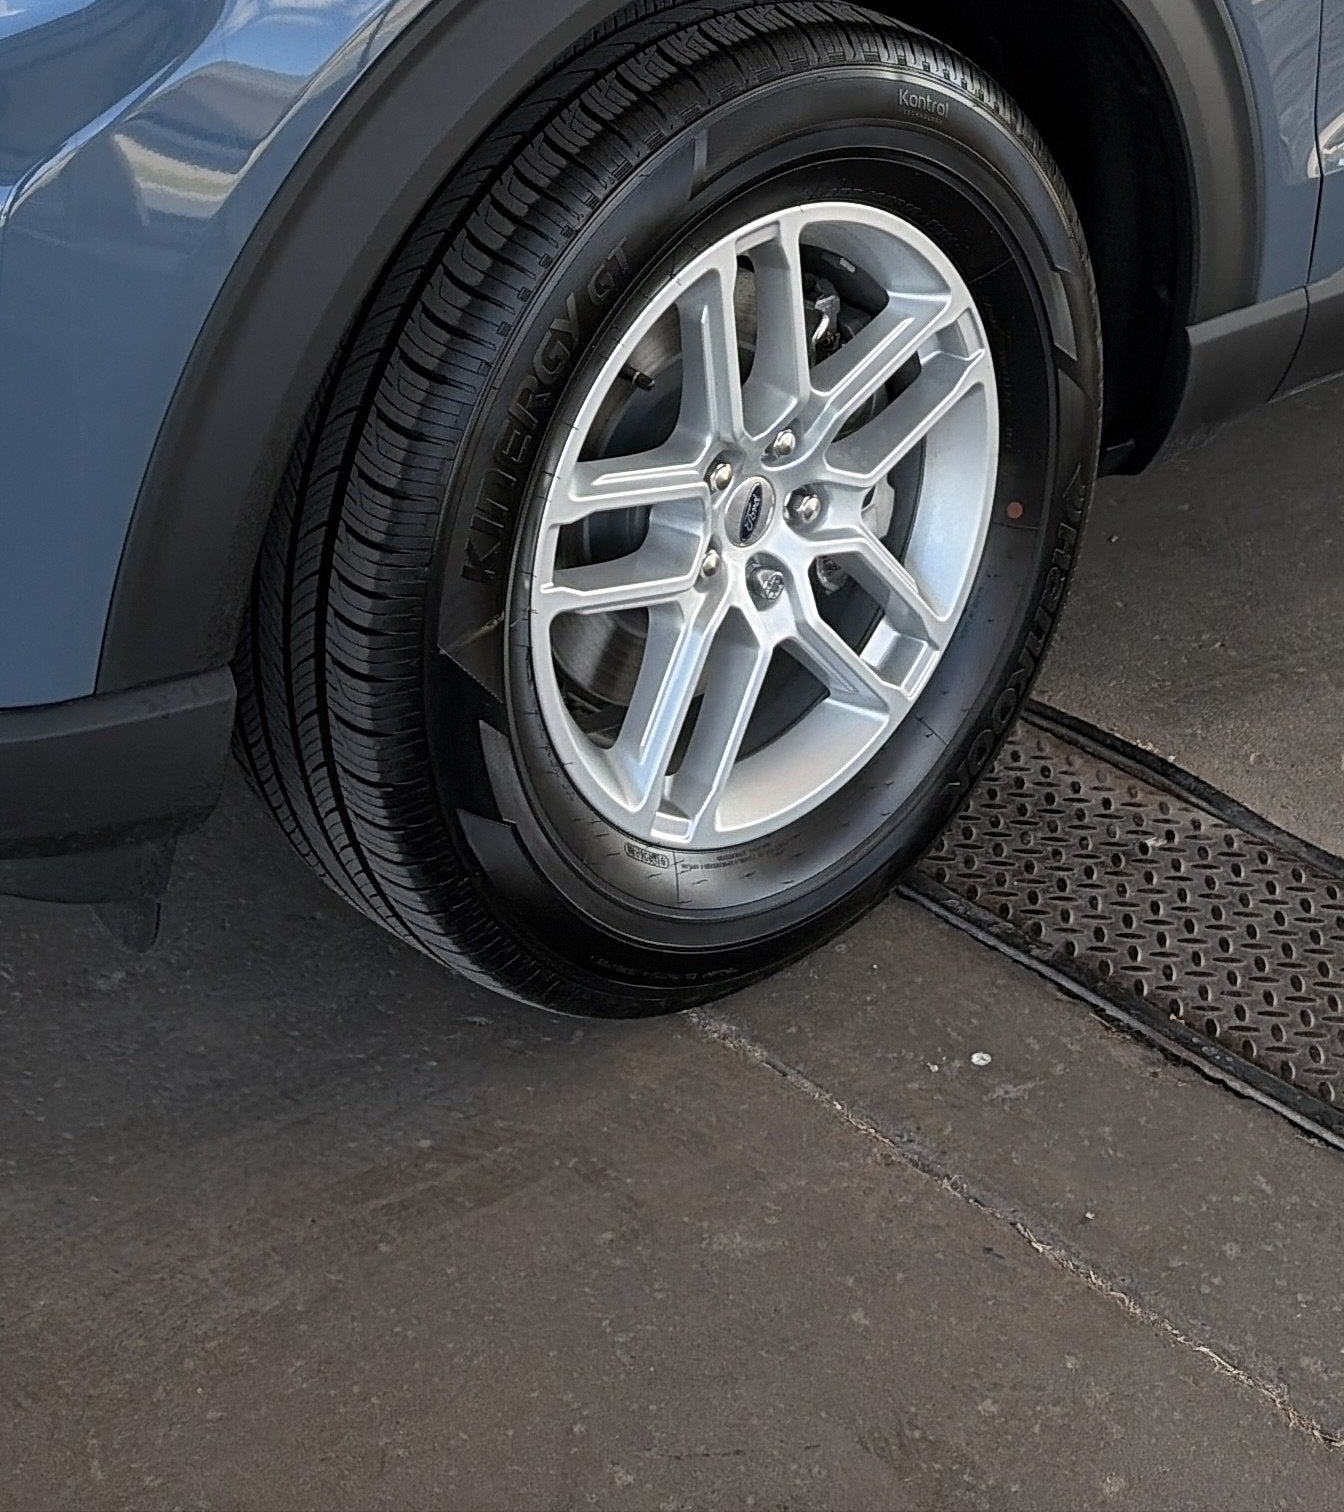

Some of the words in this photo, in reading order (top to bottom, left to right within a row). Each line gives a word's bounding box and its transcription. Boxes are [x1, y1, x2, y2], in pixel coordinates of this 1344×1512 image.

[898, 88, 950, 119] Kontrol
[460, 291, 582, 582] KINERGY
[587, 236, 631, 305] GT
[743, 493, 761, 532] Ford
